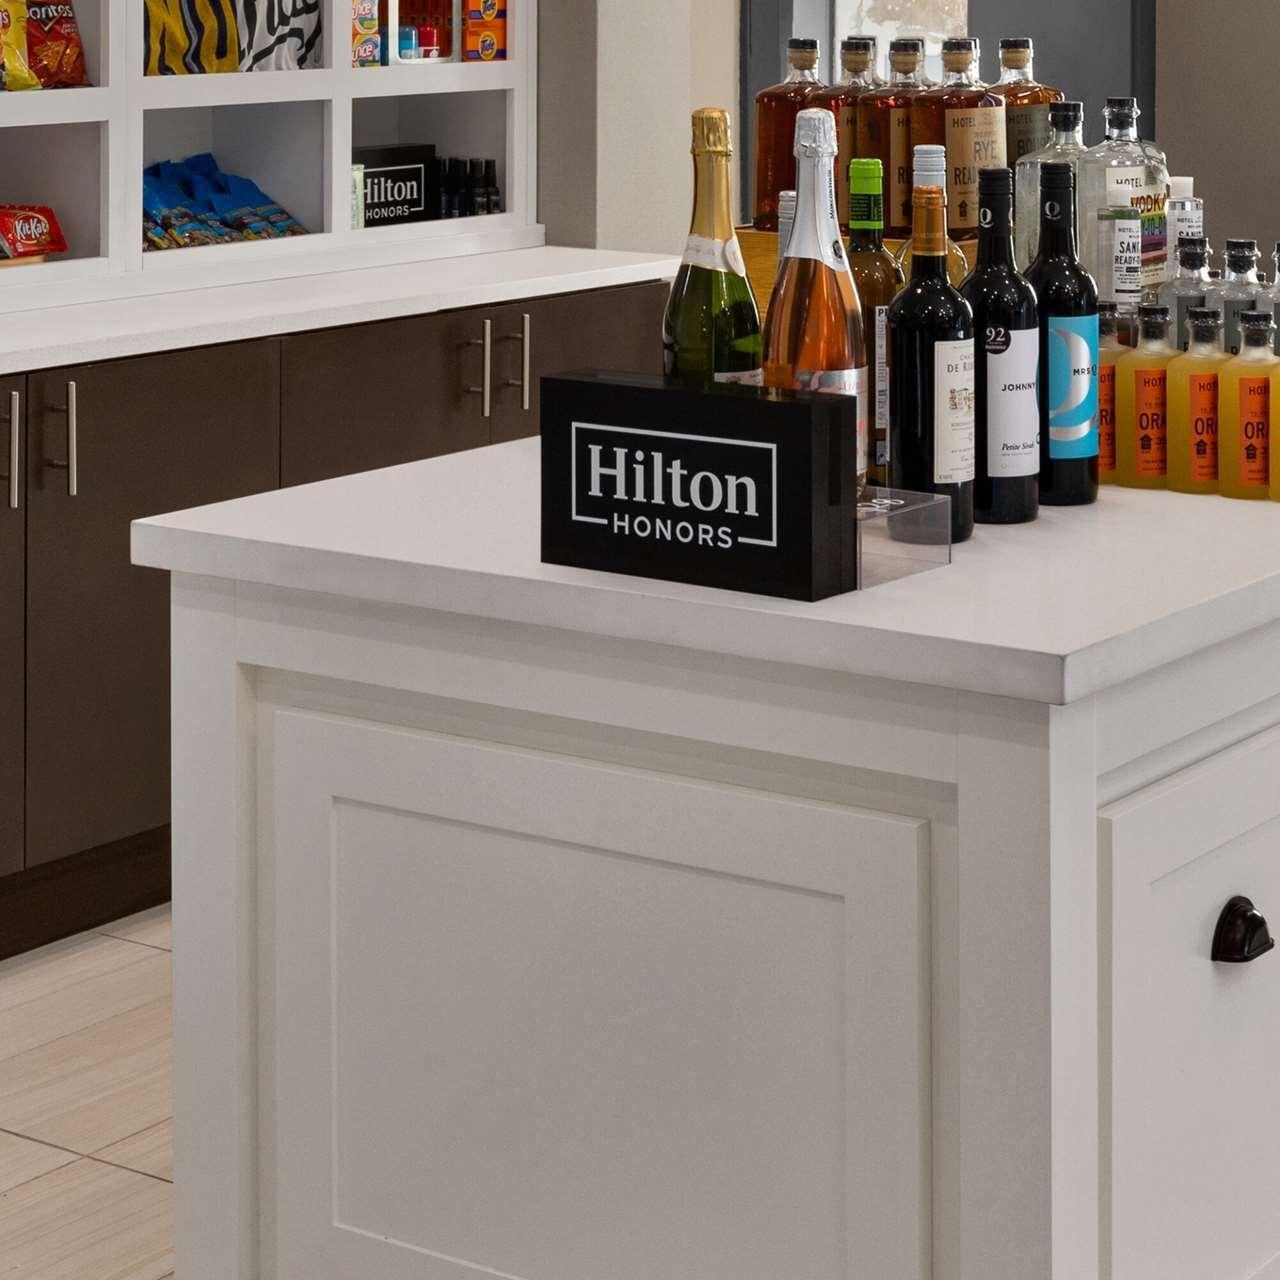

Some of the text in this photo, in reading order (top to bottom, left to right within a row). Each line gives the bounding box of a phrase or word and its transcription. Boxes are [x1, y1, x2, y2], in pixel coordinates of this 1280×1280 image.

[26, 4, 74, 22] oritos
[366, 205, 410, 220] HONORS
[986, 327, 1006, 342] 92
[587, 443, 760, 518] Hilton
[613, 512, 733, 549] HONORS
